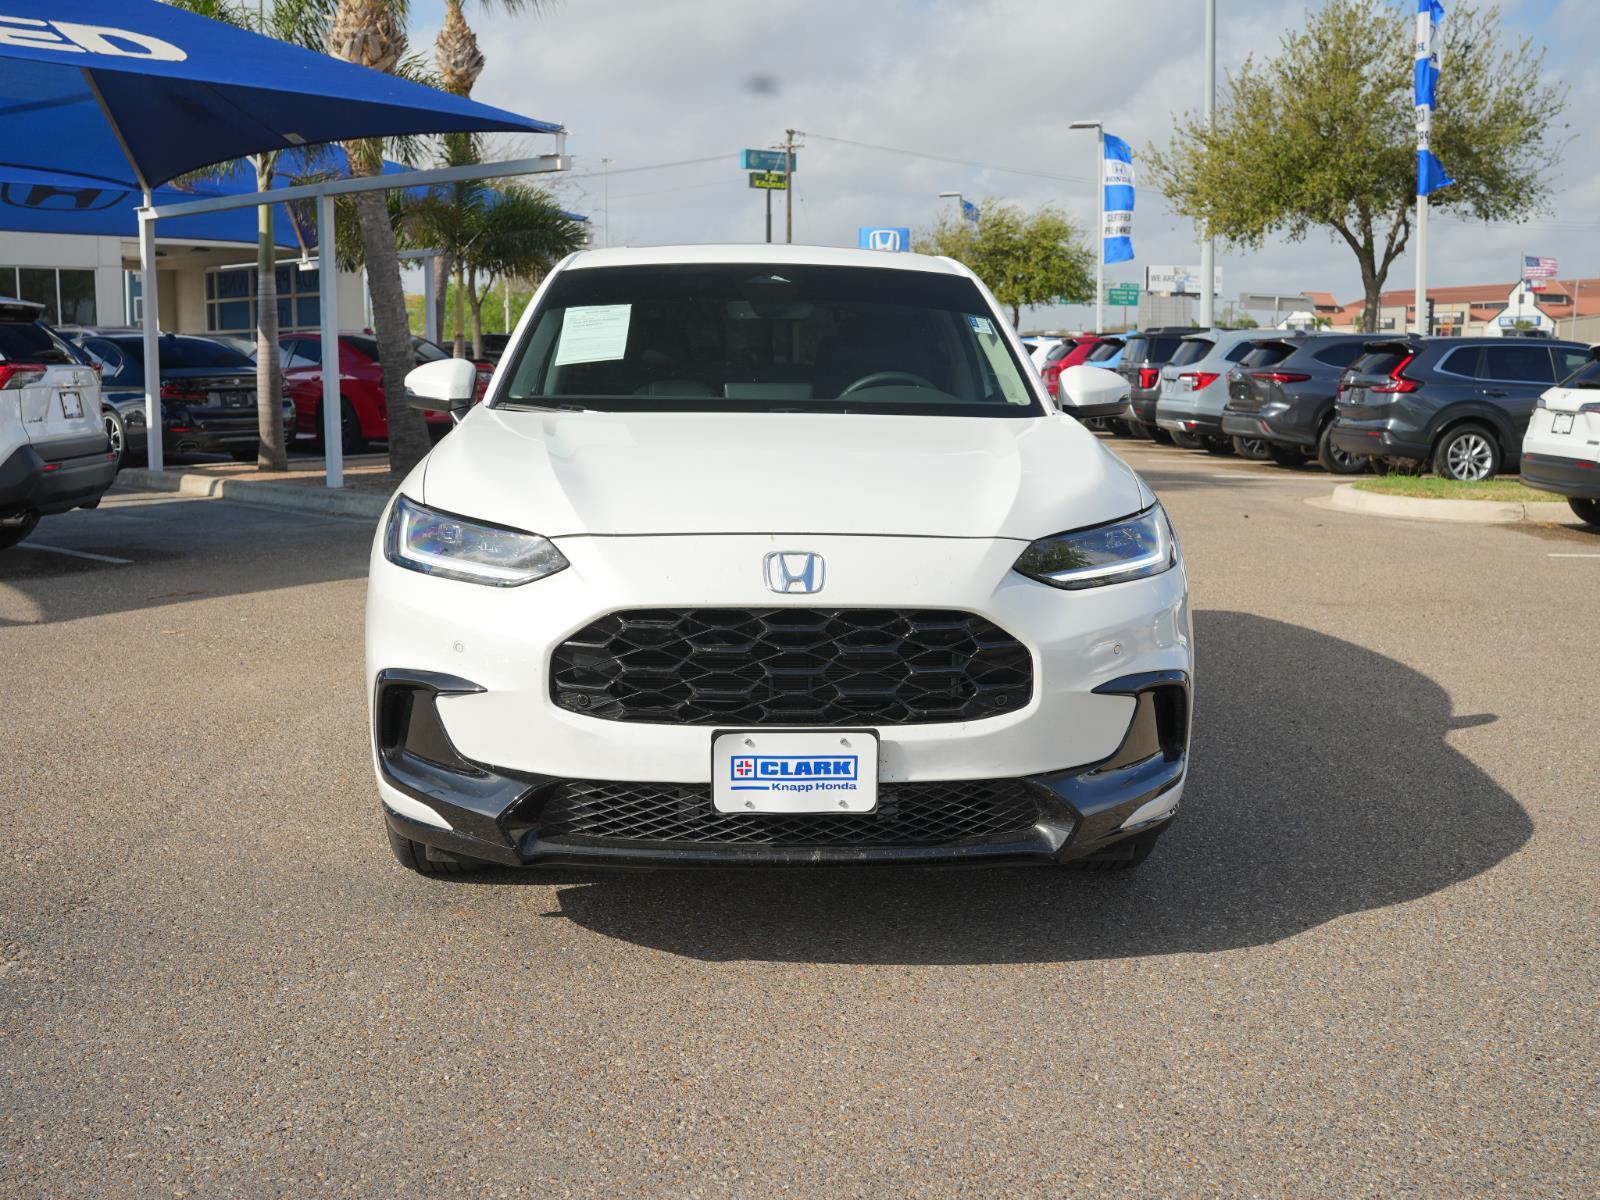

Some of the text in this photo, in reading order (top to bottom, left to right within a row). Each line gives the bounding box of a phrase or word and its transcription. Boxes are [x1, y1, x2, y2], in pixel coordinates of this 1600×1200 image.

[0, 15, 188, 62] ED
[1151, 274, 1161, 282] WE
[760, 761, 852, 776] CLARK
[772, 782, 857, 792] Knapp Honda
